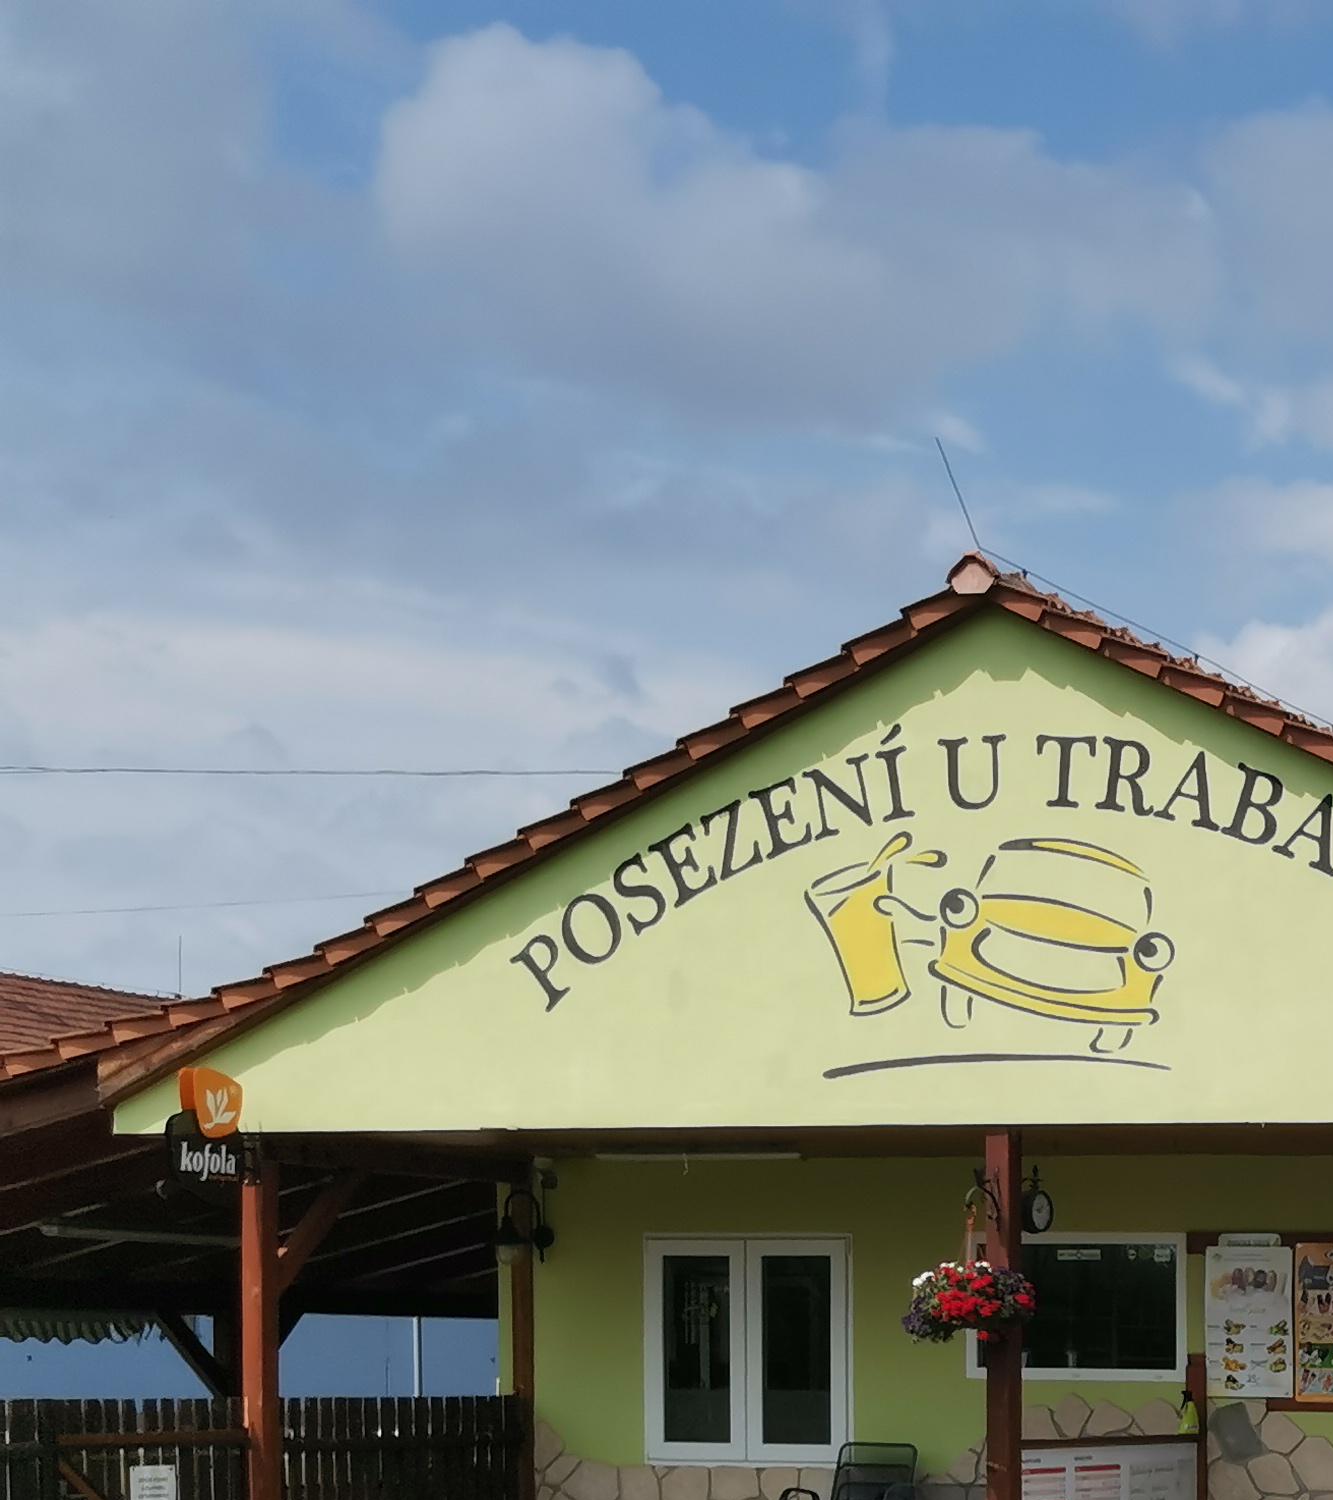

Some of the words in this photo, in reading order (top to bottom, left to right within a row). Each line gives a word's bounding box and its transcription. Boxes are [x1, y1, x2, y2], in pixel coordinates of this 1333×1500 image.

[510, 724, 916, 1012] POSEZENÍ
[937, 733, 1008, 811] U
[180, 1141, 236, 1182] kofola
